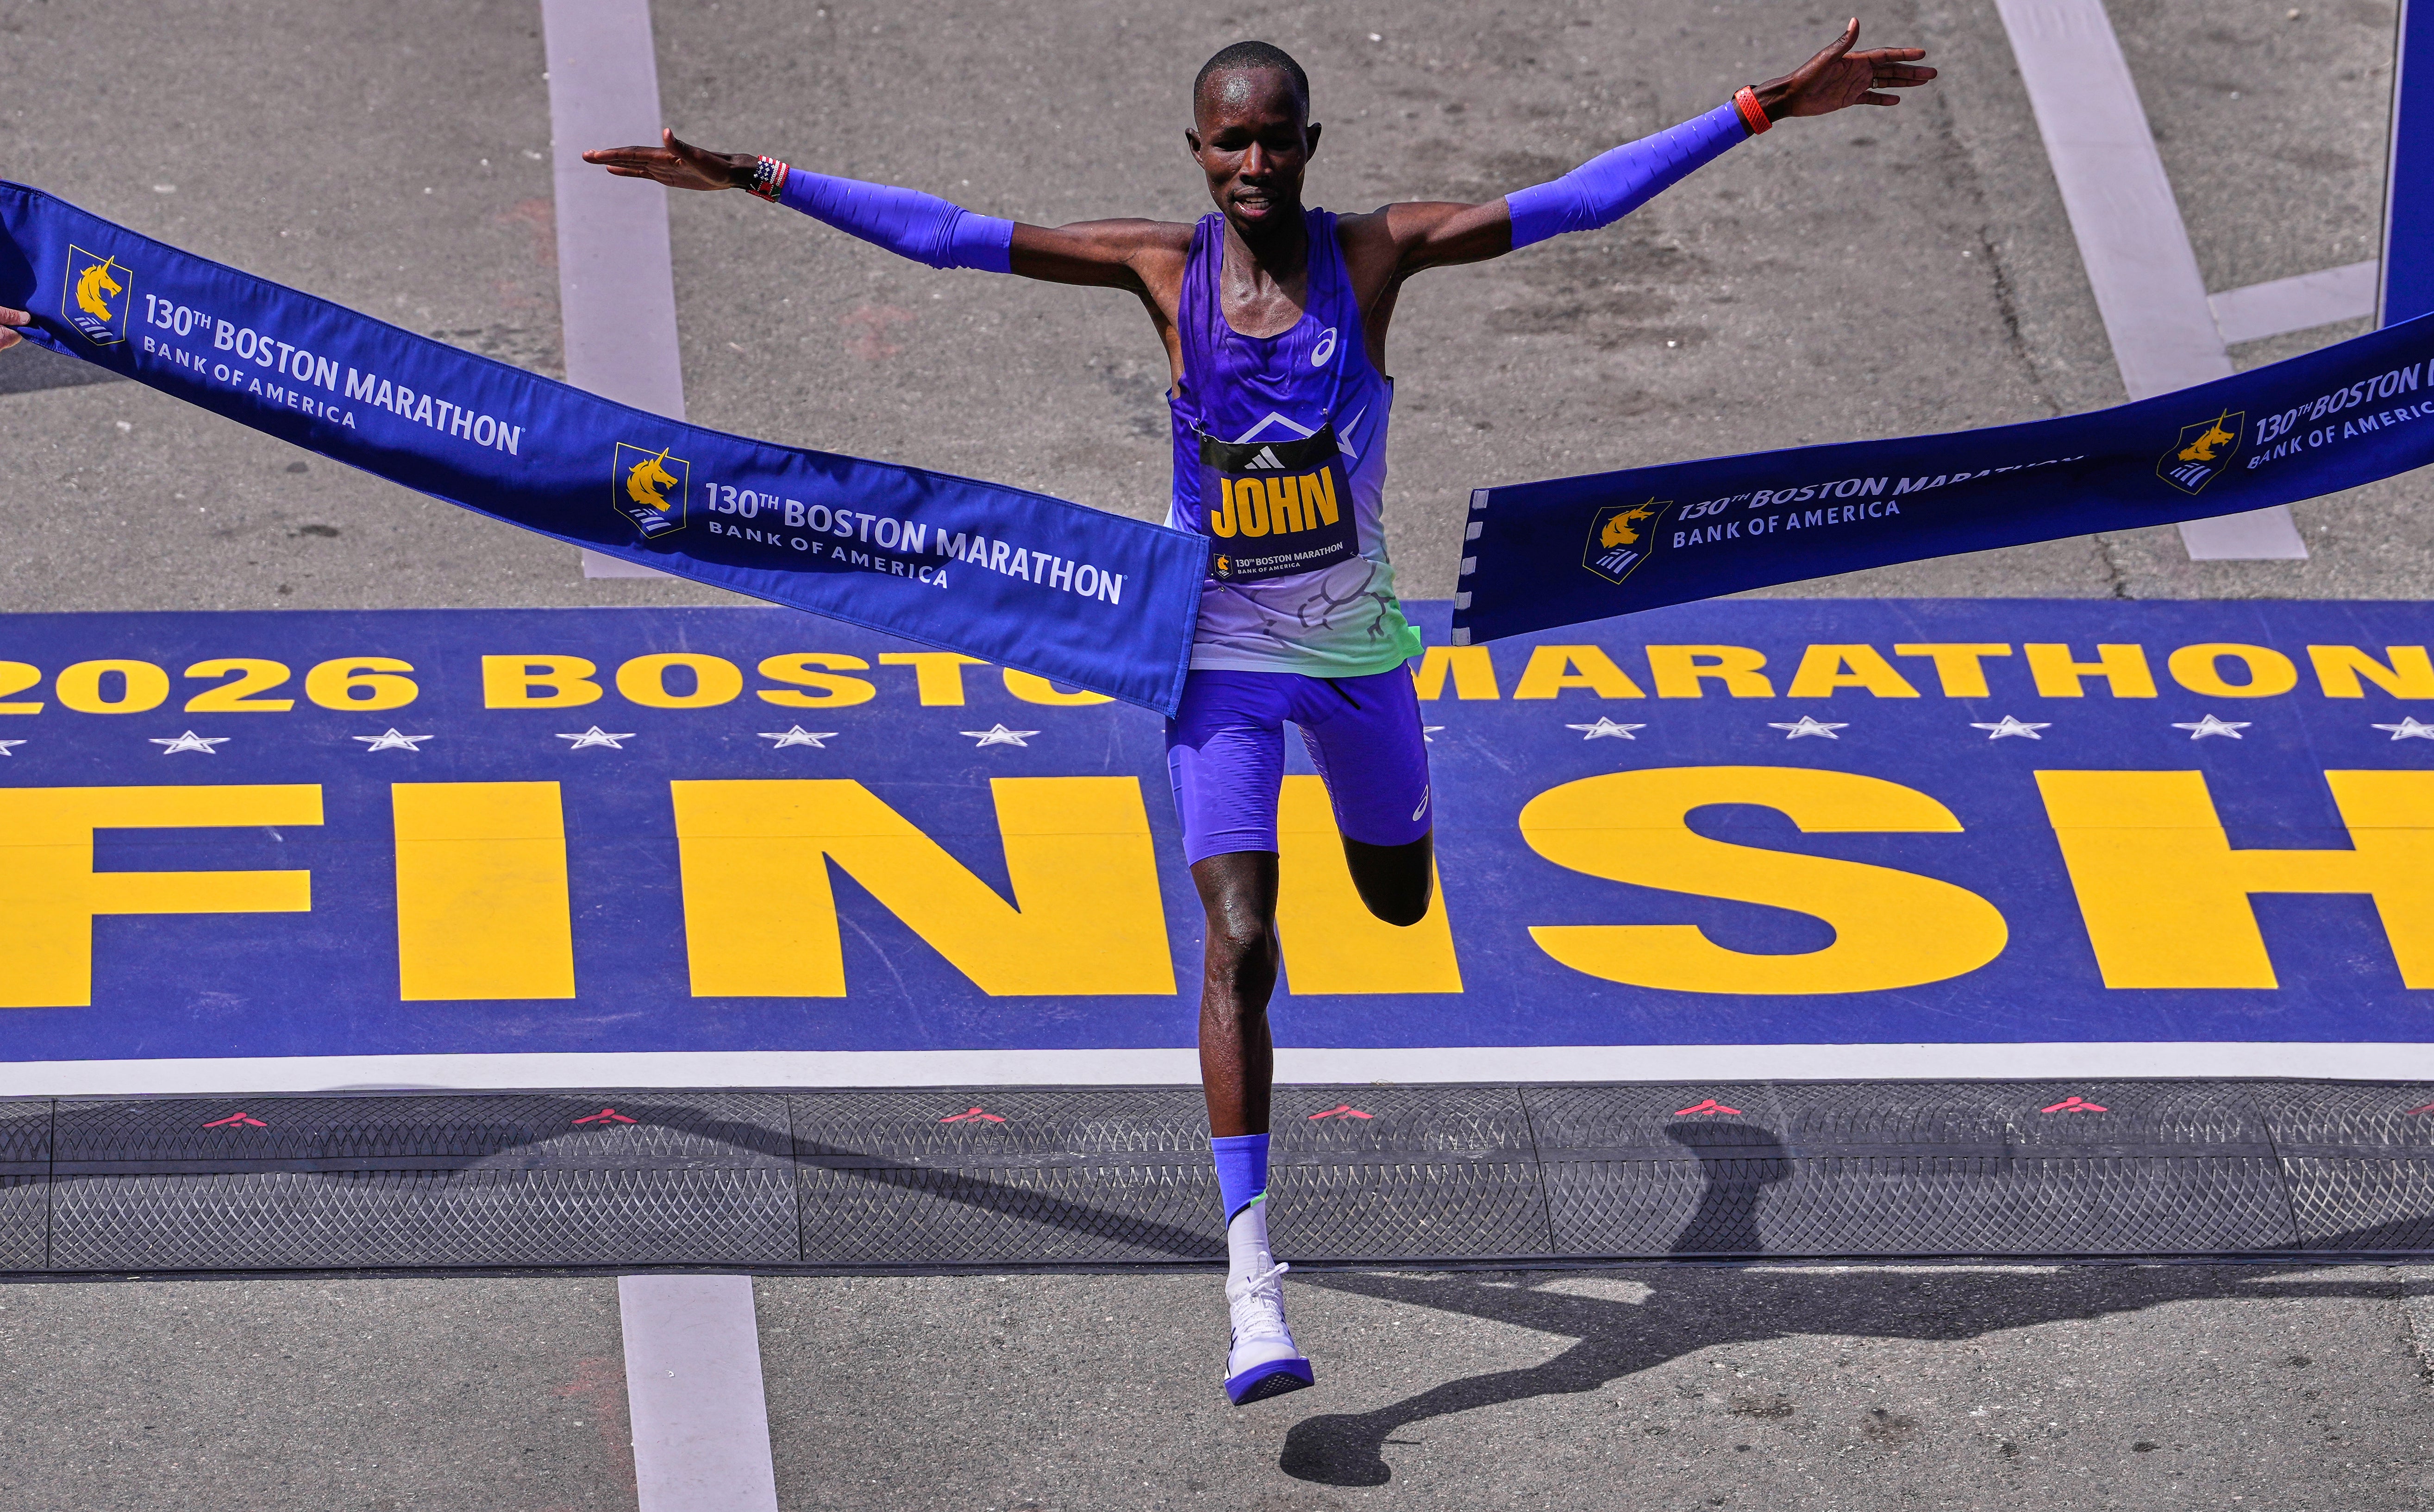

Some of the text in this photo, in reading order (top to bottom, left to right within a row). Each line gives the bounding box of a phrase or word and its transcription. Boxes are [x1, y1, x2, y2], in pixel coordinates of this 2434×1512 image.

[144, 336, 356, 429] BANK OF AMERICA
[146, 294, 521, 456] 130TH BOSTON MARATHON
[2256, 401, 2313, 445] 130TH
[2309, 362, 2421, 422] BOSTON
[2246, 433, 2302, 469] BANK
[2309, 425, 2335, 448] OF
[1211, 466, 1339, 538] JOHN
[1673, 500, 1900, 549] BANK OF AMERICA
[1678, 492, 1751, 521] 130TH
[1749, 477, 1889, 509] BOSTON
[706, 482, 1123, 605] 130TH BOSTON MARATHON
[709, 521, 947, 589] BANK OF AMERICA
[1235, 541, 1343, 567] 130TH BOSTON MARATHON
[1268, 562, 1301, 571] AMERICA
[483, 653, 1118, 708] BOST
[1411, 644, 2434, 700] MARATHON
[0, 765, 2434, 1008] FINISH
